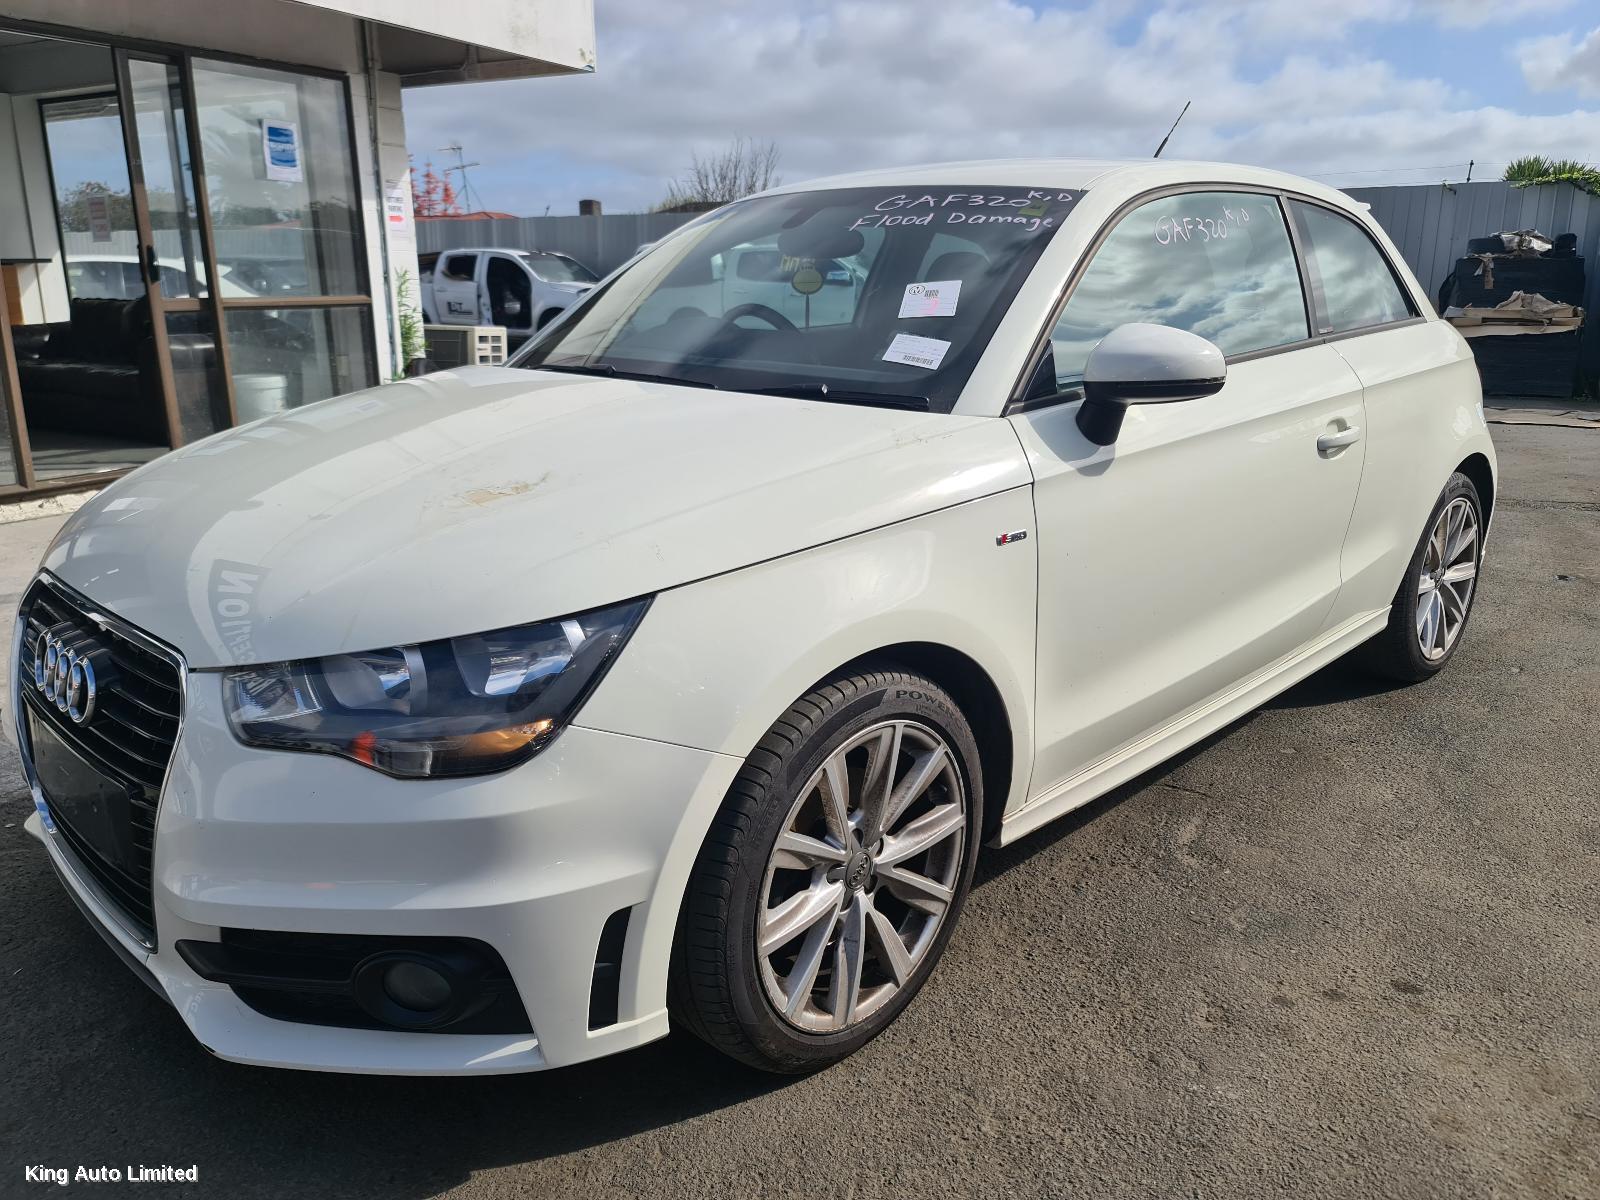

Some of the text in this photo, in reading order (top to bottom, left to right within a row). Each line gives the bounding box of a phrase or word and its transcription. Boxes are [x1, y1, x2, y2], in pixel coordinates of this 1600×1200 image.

[874, 193, 1031, 211] GAF320
[849, 212, 1054, 232] Flood Damage
[1155, 215, 1227, 245] GAF320
